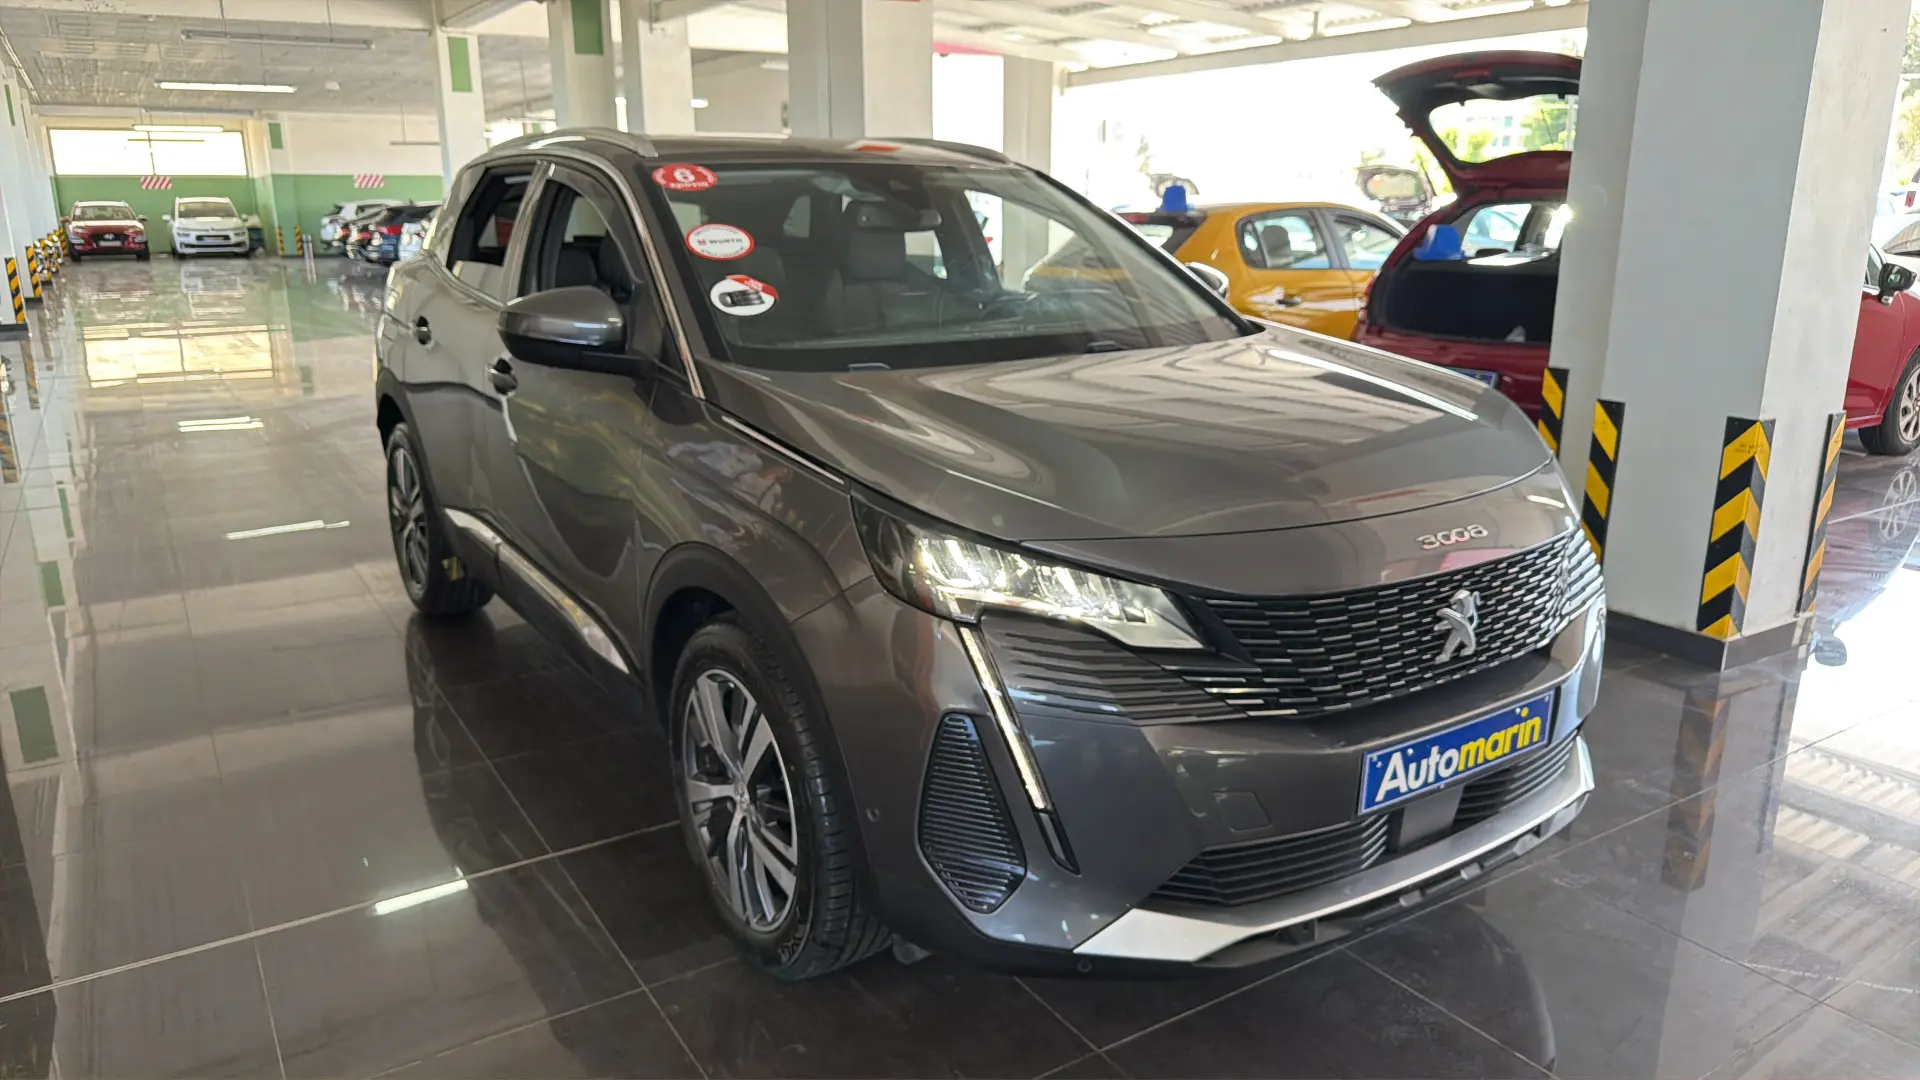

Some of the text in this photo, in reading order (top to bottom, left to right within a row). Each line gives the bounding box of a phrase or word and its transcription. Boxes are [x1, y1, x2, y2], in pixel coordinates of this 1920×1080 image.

[674, 168, 695, 182] 6
[1416, 524, 1488, 549] 3008
[1375, 707, 1542, 802] Automarin
